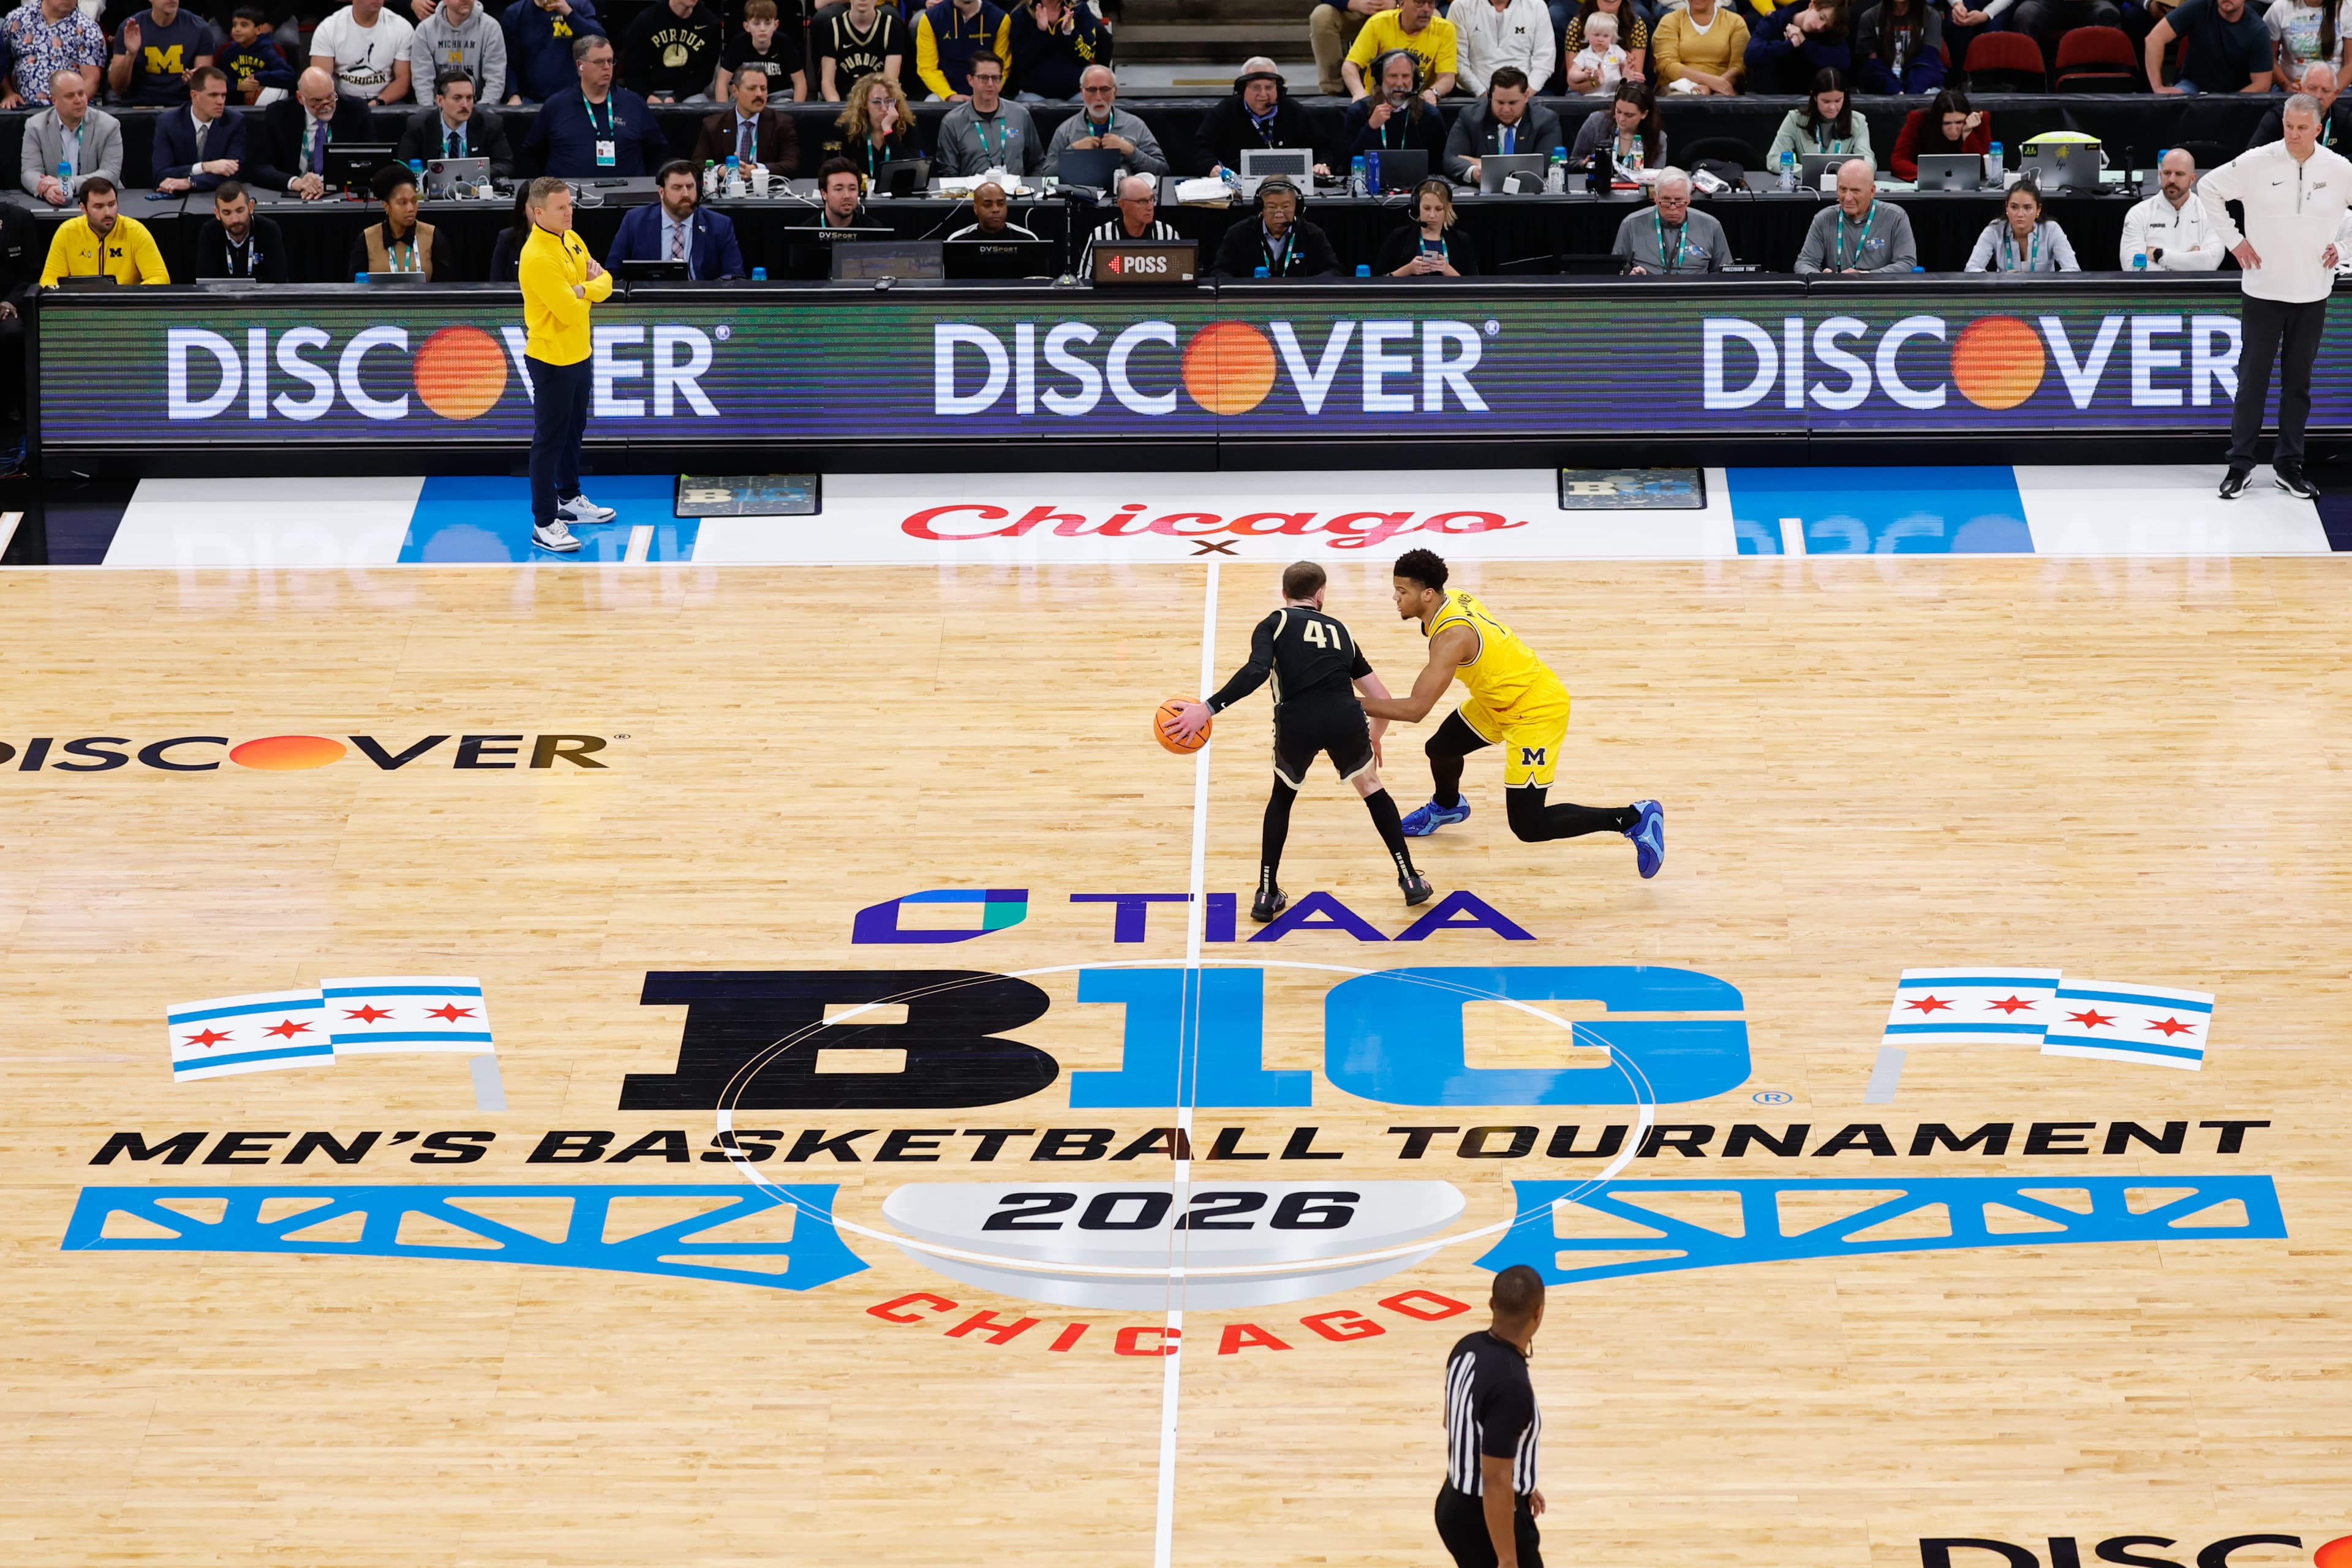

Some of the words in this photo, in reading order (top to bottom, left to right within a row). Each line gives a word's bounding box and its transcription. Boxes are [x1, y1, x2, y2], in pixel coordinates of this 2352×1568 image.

[553, 21, 573, 37] M
[651, 28, 706, 51] PURDUE
[145, 44, 184, 74] M
[840, 53, 884, 73] PURDUE
[110, 248, 123, 257] M
[1123, 256, 1167, 274] POSS
[934, 320, 1490, 416] DISCOVER
[902, 503, 1528, 549] Chicago
[1303, 619, 1341, 650] 41
[0, 735, 608, 772] ISCOVER
[1521, 747, 1545, 766] M
[1071, 891, 1535, 942] TIAA
[89, 1131, 496, 1165] MEN'S
[526, 1127, 1344, 1163] BASKETBALL
[1387, 1120, 2271, 1160] TOURNAMENT
[981, 1191, 1360, 1231] 2026
[866, 1290, 1471, 1356] CHICAGO
